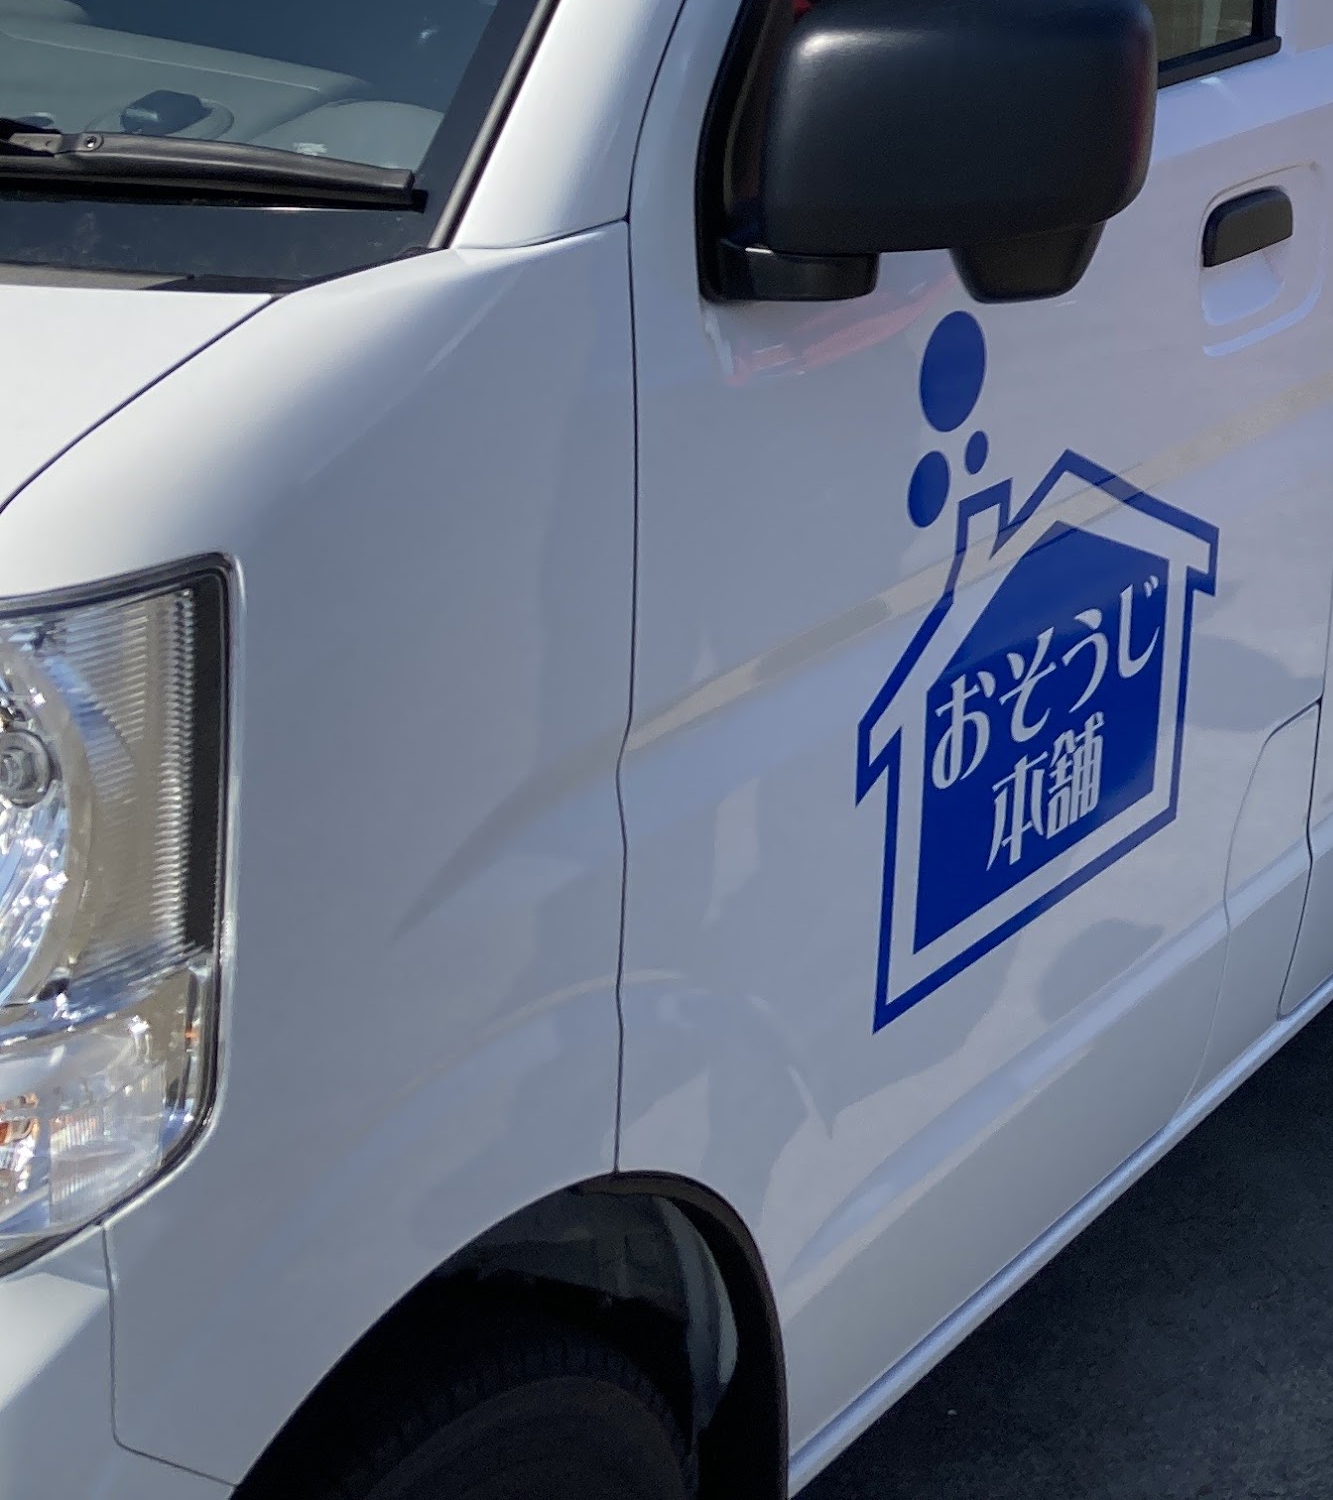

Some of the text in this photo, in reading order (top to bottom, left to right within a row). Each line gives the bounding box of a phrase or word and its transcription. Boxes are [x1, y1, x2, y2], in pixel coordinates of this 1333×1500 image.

[931, 575, 1160, 790] おそうじ
[986, 711, 1105, 872] 本舗
